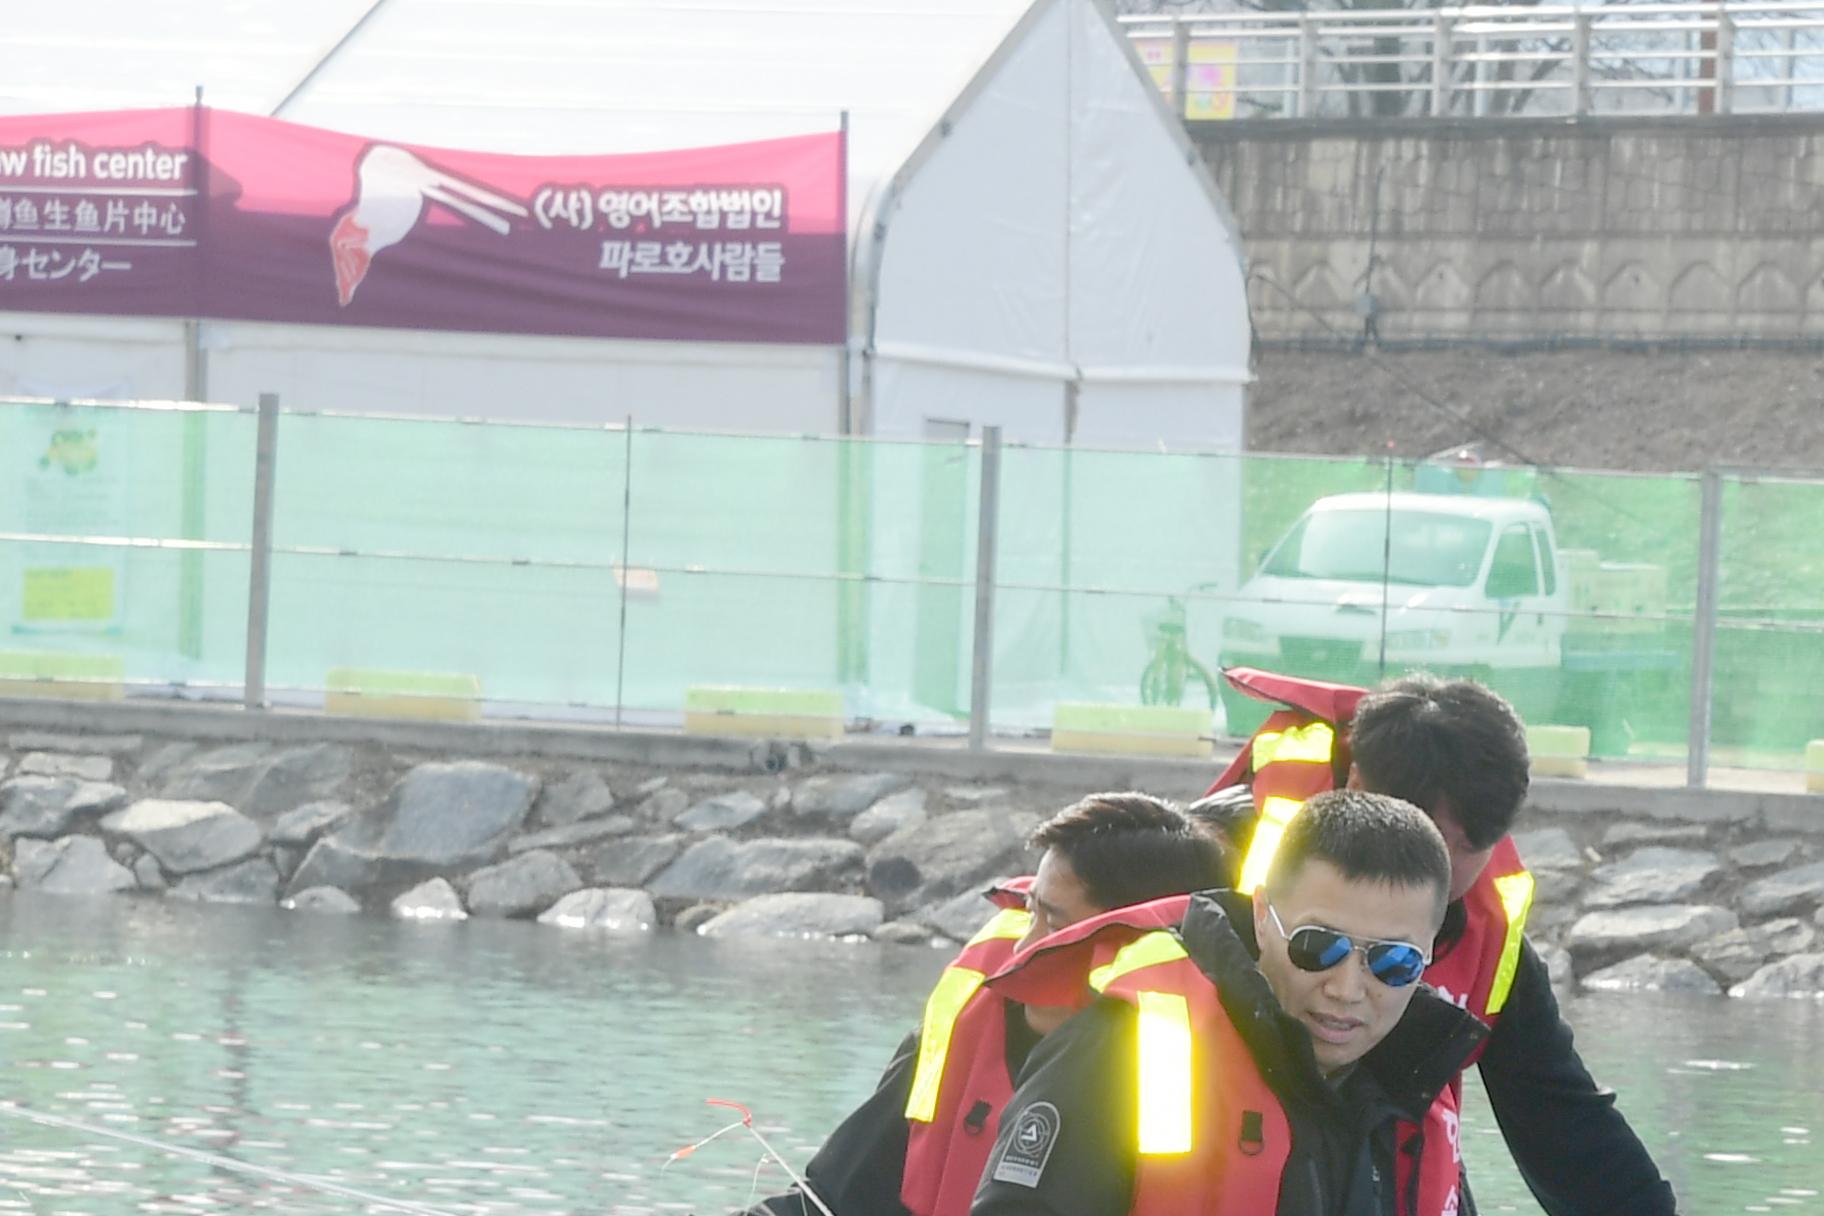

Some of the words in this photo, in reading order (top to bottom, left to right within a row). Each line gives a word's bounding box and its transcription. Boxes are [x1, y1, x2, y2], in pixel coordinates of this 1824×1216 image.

[33, 144, 87, 178] fish
[92, 147, 189, 180] center
[598, 189, 782, 229] 영어조합법인
[599, 240, 786, 282] 파로호사람들
